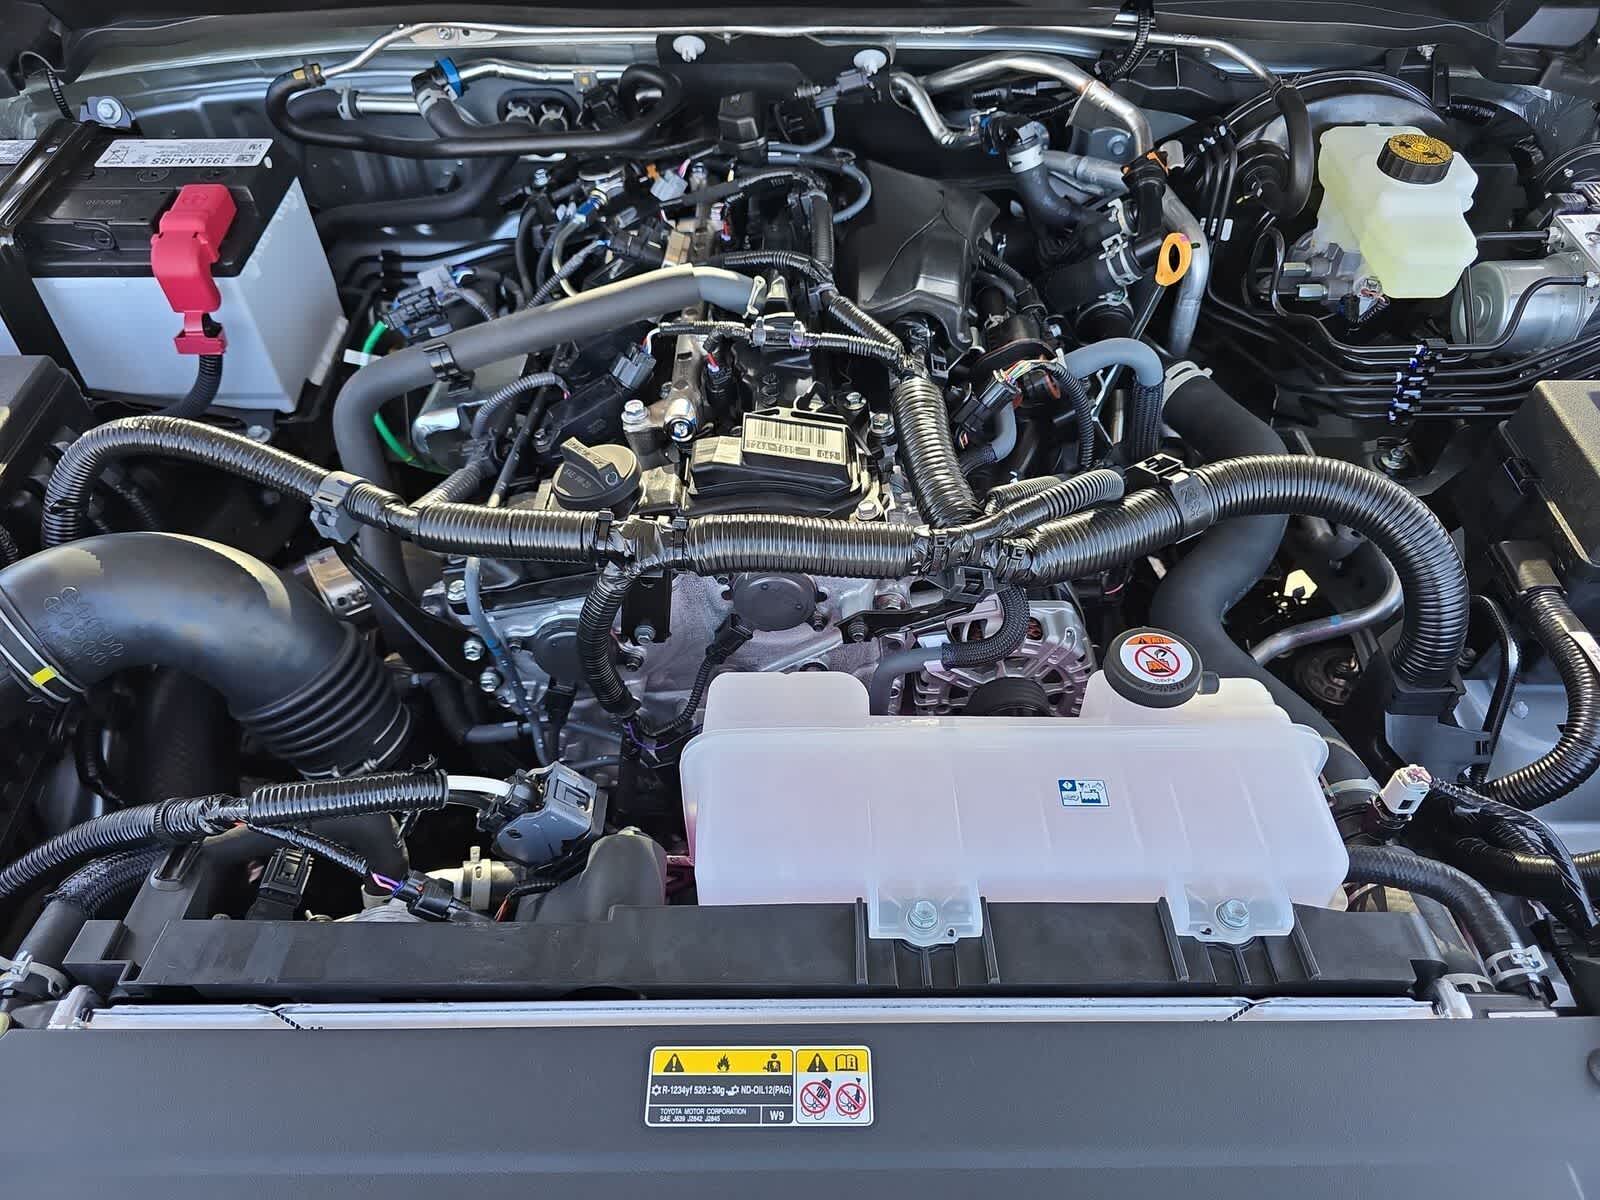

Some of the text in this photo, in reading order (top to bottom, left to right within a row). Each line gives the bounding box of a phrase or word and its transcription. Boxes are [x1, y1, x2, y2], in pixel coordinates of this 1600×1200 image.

[662, 1085, 792, 1096] R-1234yf 520±30g ND-OIL12(PAG)
[769, 1110, 785, 1121] W9
